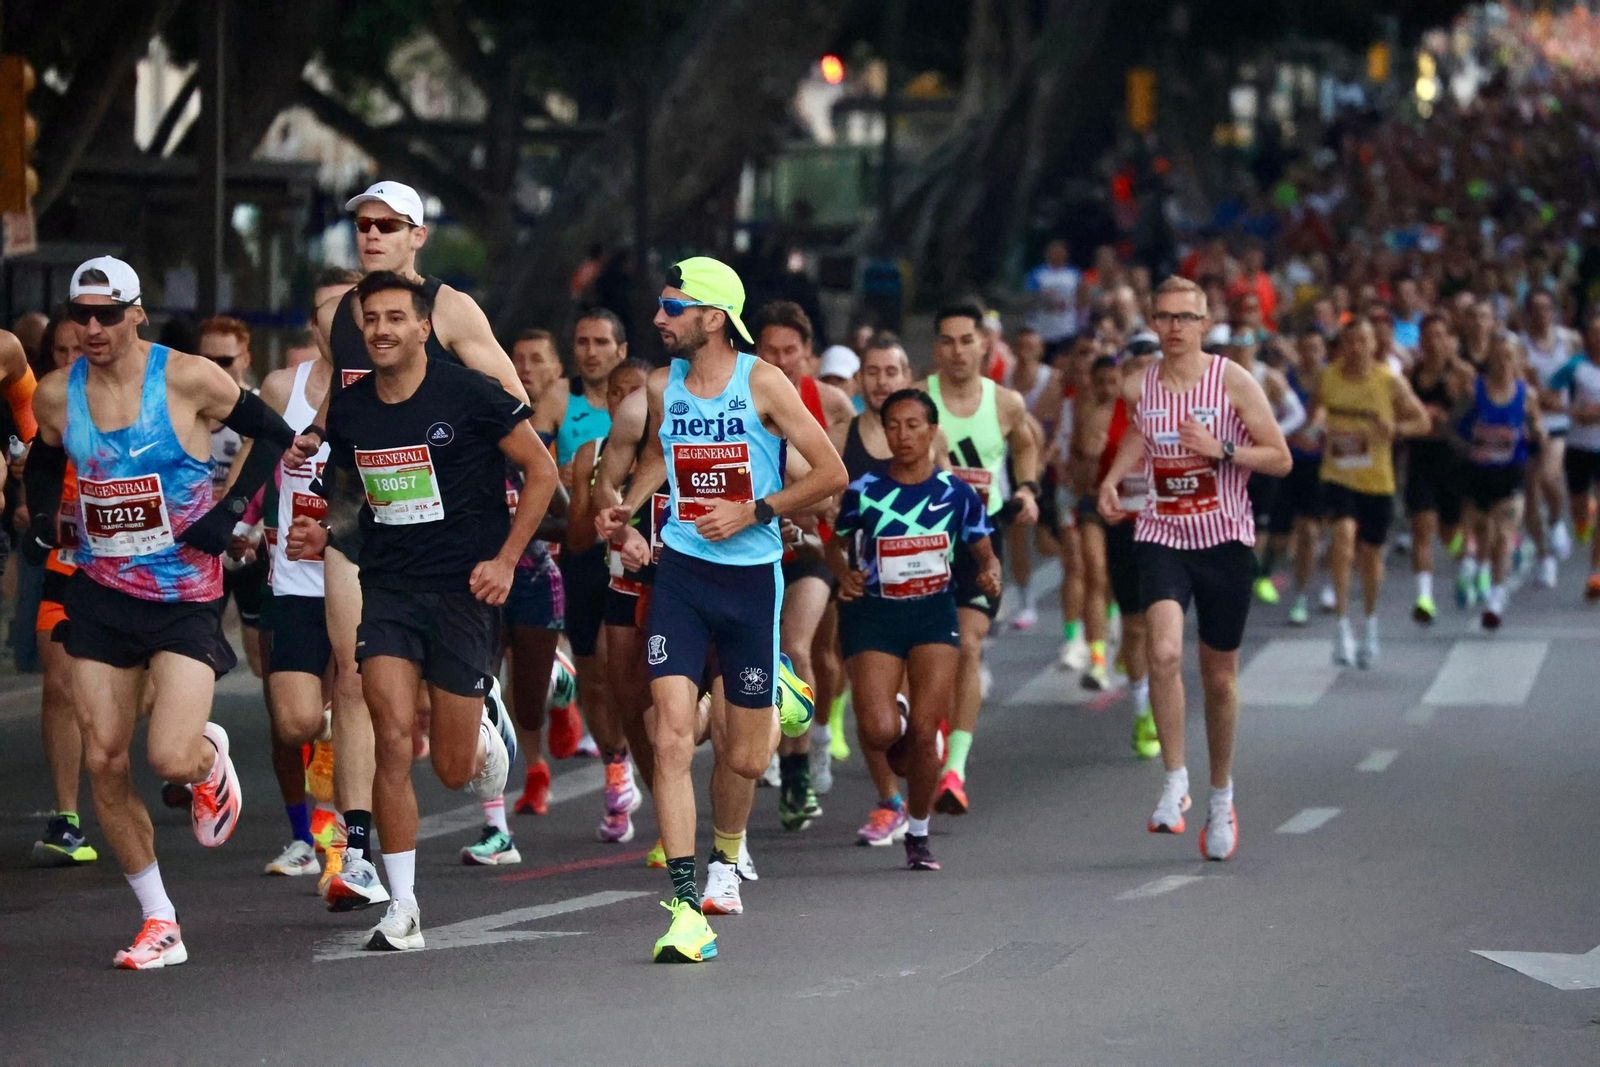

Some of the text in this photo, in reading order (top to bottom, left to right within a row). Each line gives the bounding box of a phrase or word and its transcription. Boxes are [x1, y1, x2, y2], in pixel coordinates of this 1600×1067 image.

[670, 412, 747, 442] nerja
[371, 450, 423, 466] GENERALI
[690, 446, 742, 460] GENERALI
[374, 475, 417, 492] 18057
[691, 472, 726, 487] 6251
[94, 480, 153, 497] GENERALI
[96, 507, 146, 523] 17212
[141, 534, 156, 543] 21K
